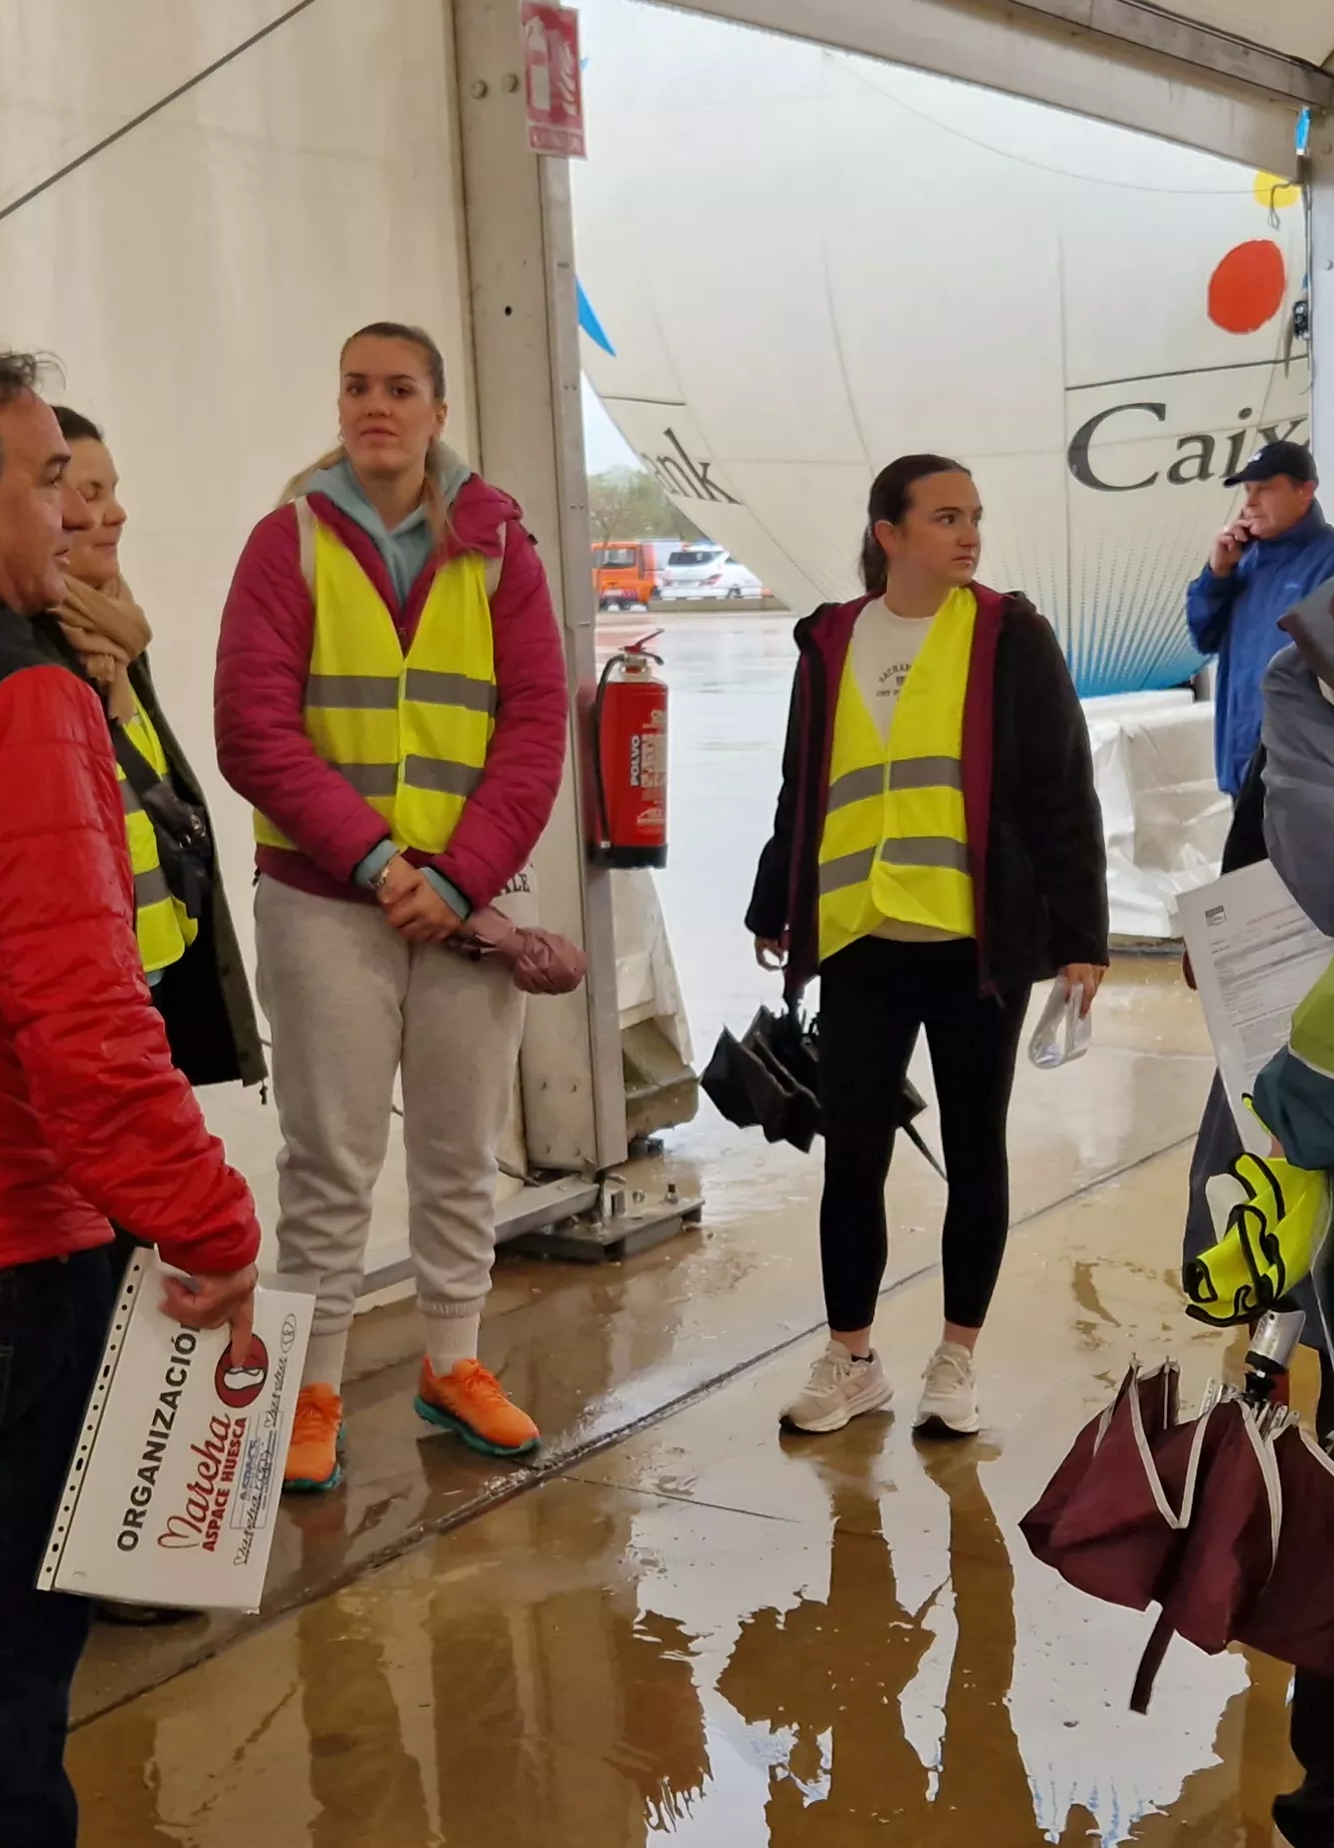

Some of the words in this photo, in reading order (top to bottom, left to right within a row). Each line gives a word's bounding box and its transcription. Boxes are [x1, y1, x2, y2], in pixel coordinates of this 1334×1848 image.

[630, 734, 641, 787] POLVO
[116, 1322, 202, 1552] ORGANIZACIÓ
[157, 1412, 233, 1550] Marcha
[202, 1487, 230, 1552] ASPACE
[220, 1417, 248, 1483] HUESCA
